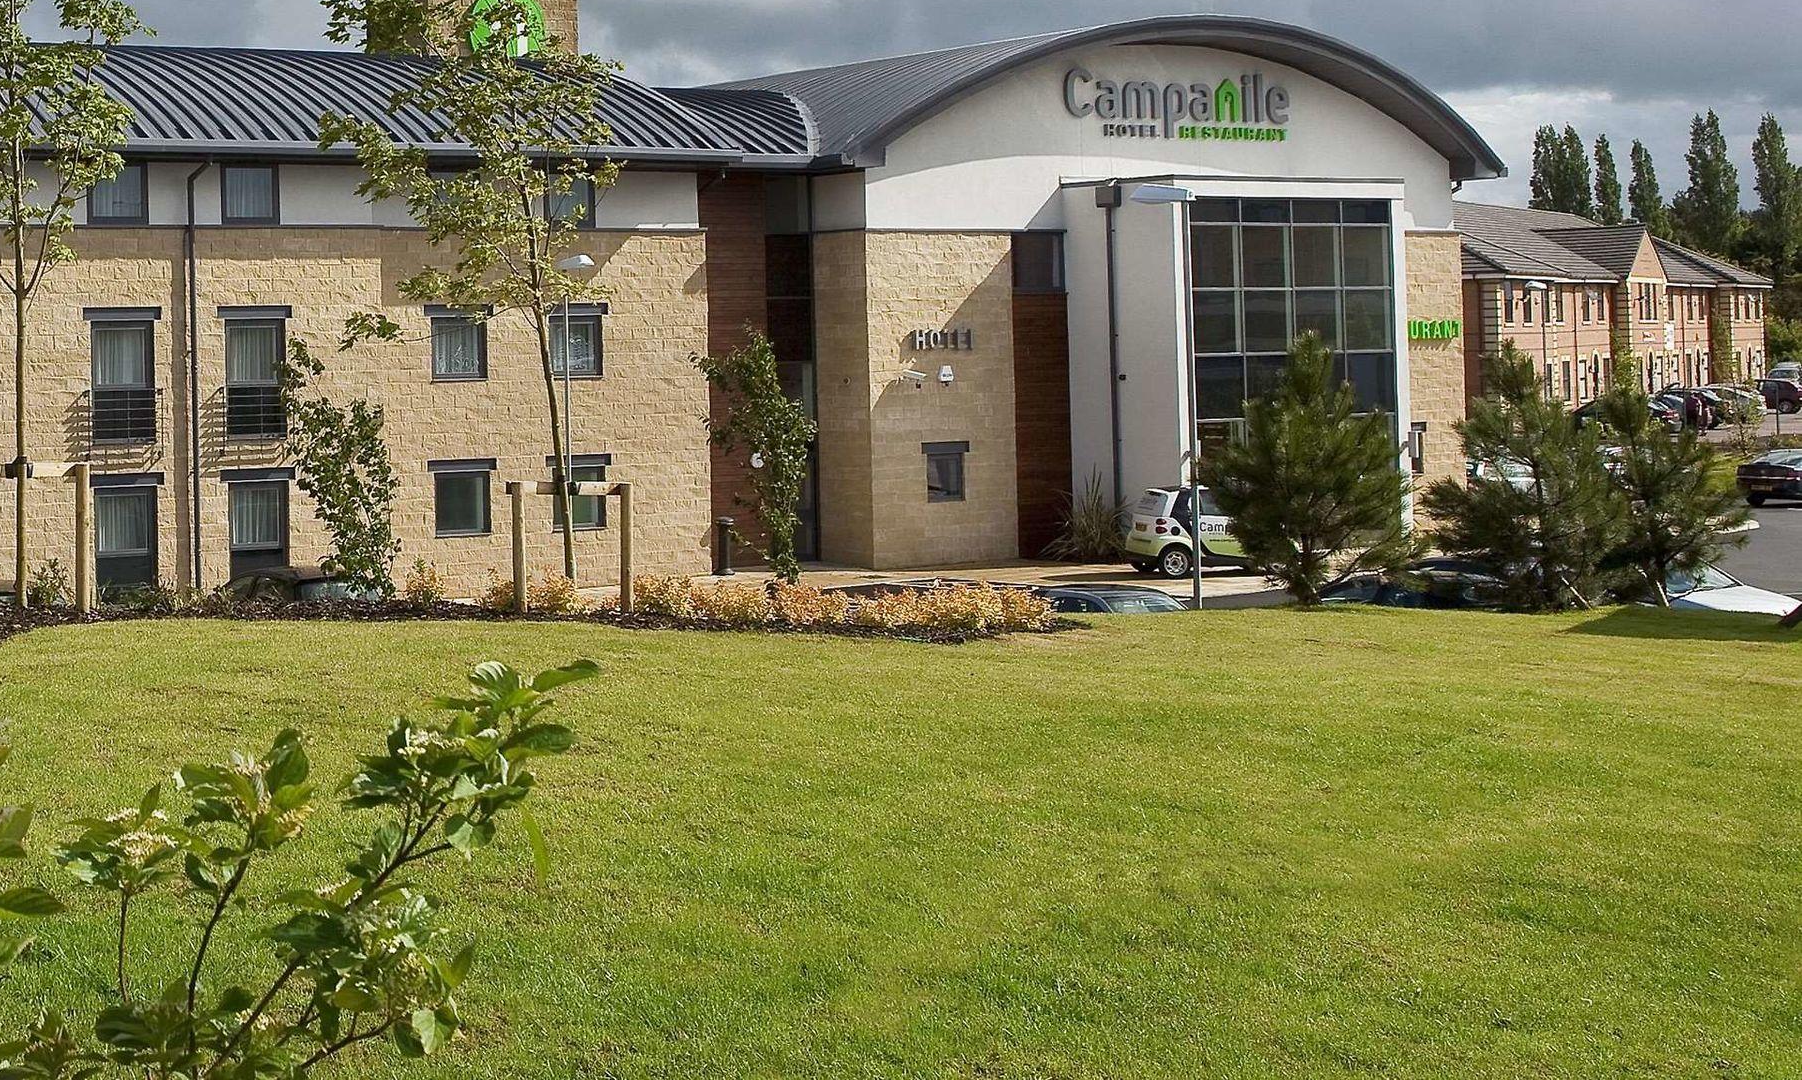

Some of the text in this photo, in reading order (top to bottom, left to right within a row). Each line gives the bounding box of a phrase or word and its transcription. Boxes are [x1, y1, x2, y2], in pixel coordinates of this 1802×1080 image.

[1063, 68, 1290, 139] Campanile
[1102, 123, 1288, 142] HOTEL RESTAURANT
